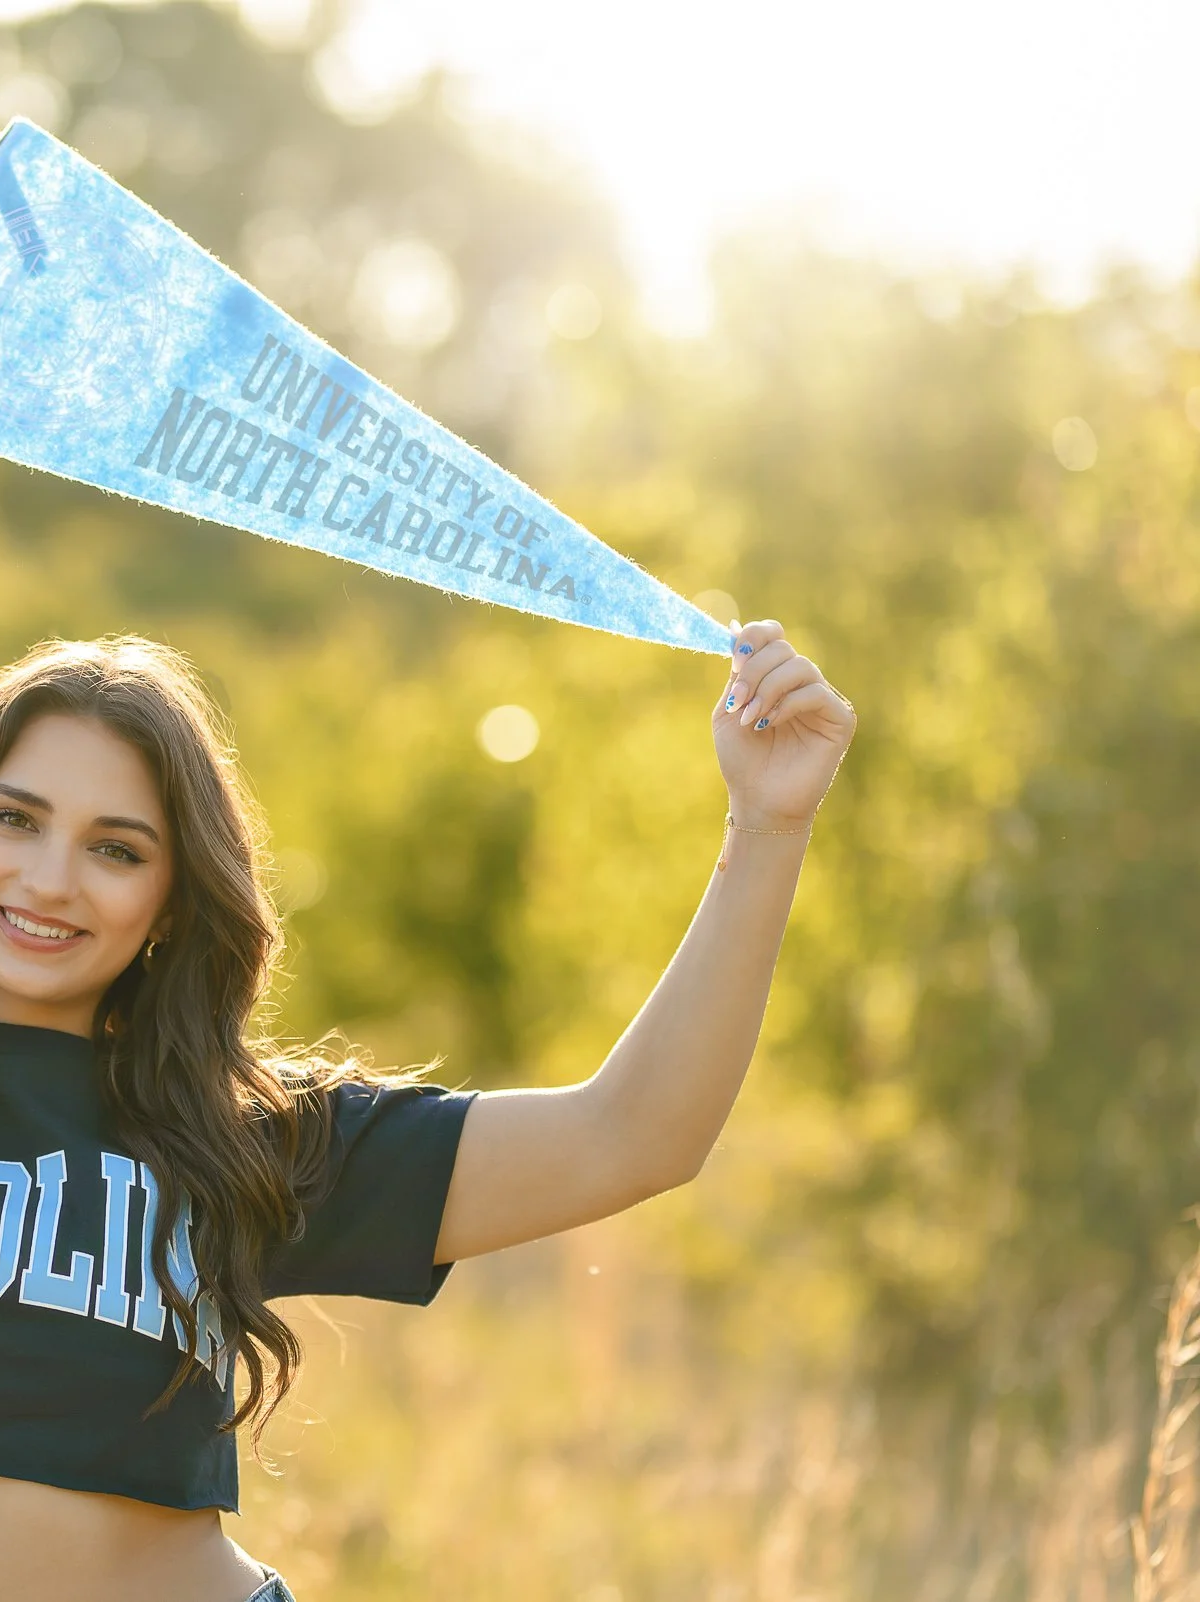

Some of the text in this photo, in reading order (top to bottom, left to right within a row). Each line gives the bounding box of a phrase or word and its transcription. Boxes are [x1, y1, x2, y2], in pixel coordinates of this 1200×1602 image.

[134, 386, 579, 602] NORTH CAROLINA
[240, 333, 550, 550] UNIVERSITY OF
